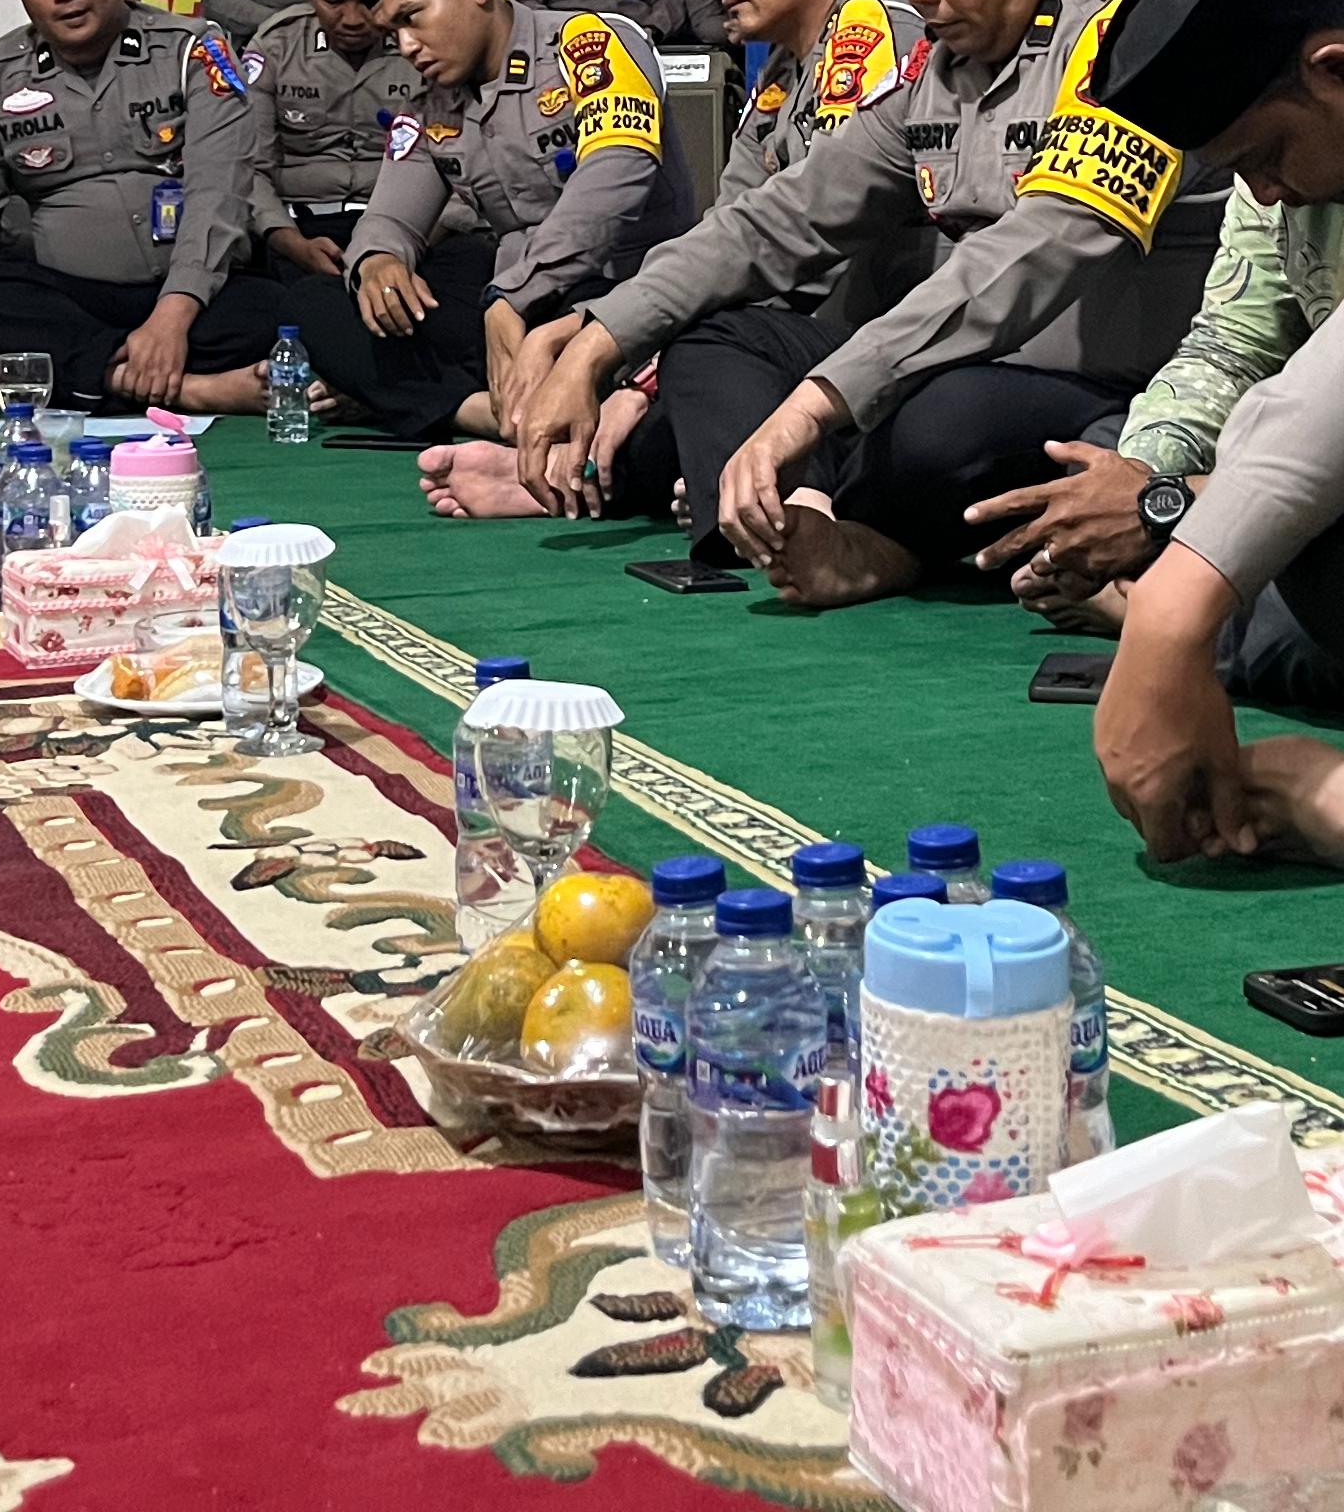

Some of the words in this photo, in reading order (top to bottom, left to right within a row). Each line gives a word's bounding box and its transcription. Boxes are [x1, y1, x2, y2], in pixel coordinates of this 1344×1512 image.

[585, 118, 603, 137] LK
[612, 114, 653, 134] 2024
[1049, 153, 1083, 178] LK
[1094, 169, 1150, 216] 2024
[1079, 137, 1157, 192] LANTAS
[635, 1010, 678, 1044] AQUA
